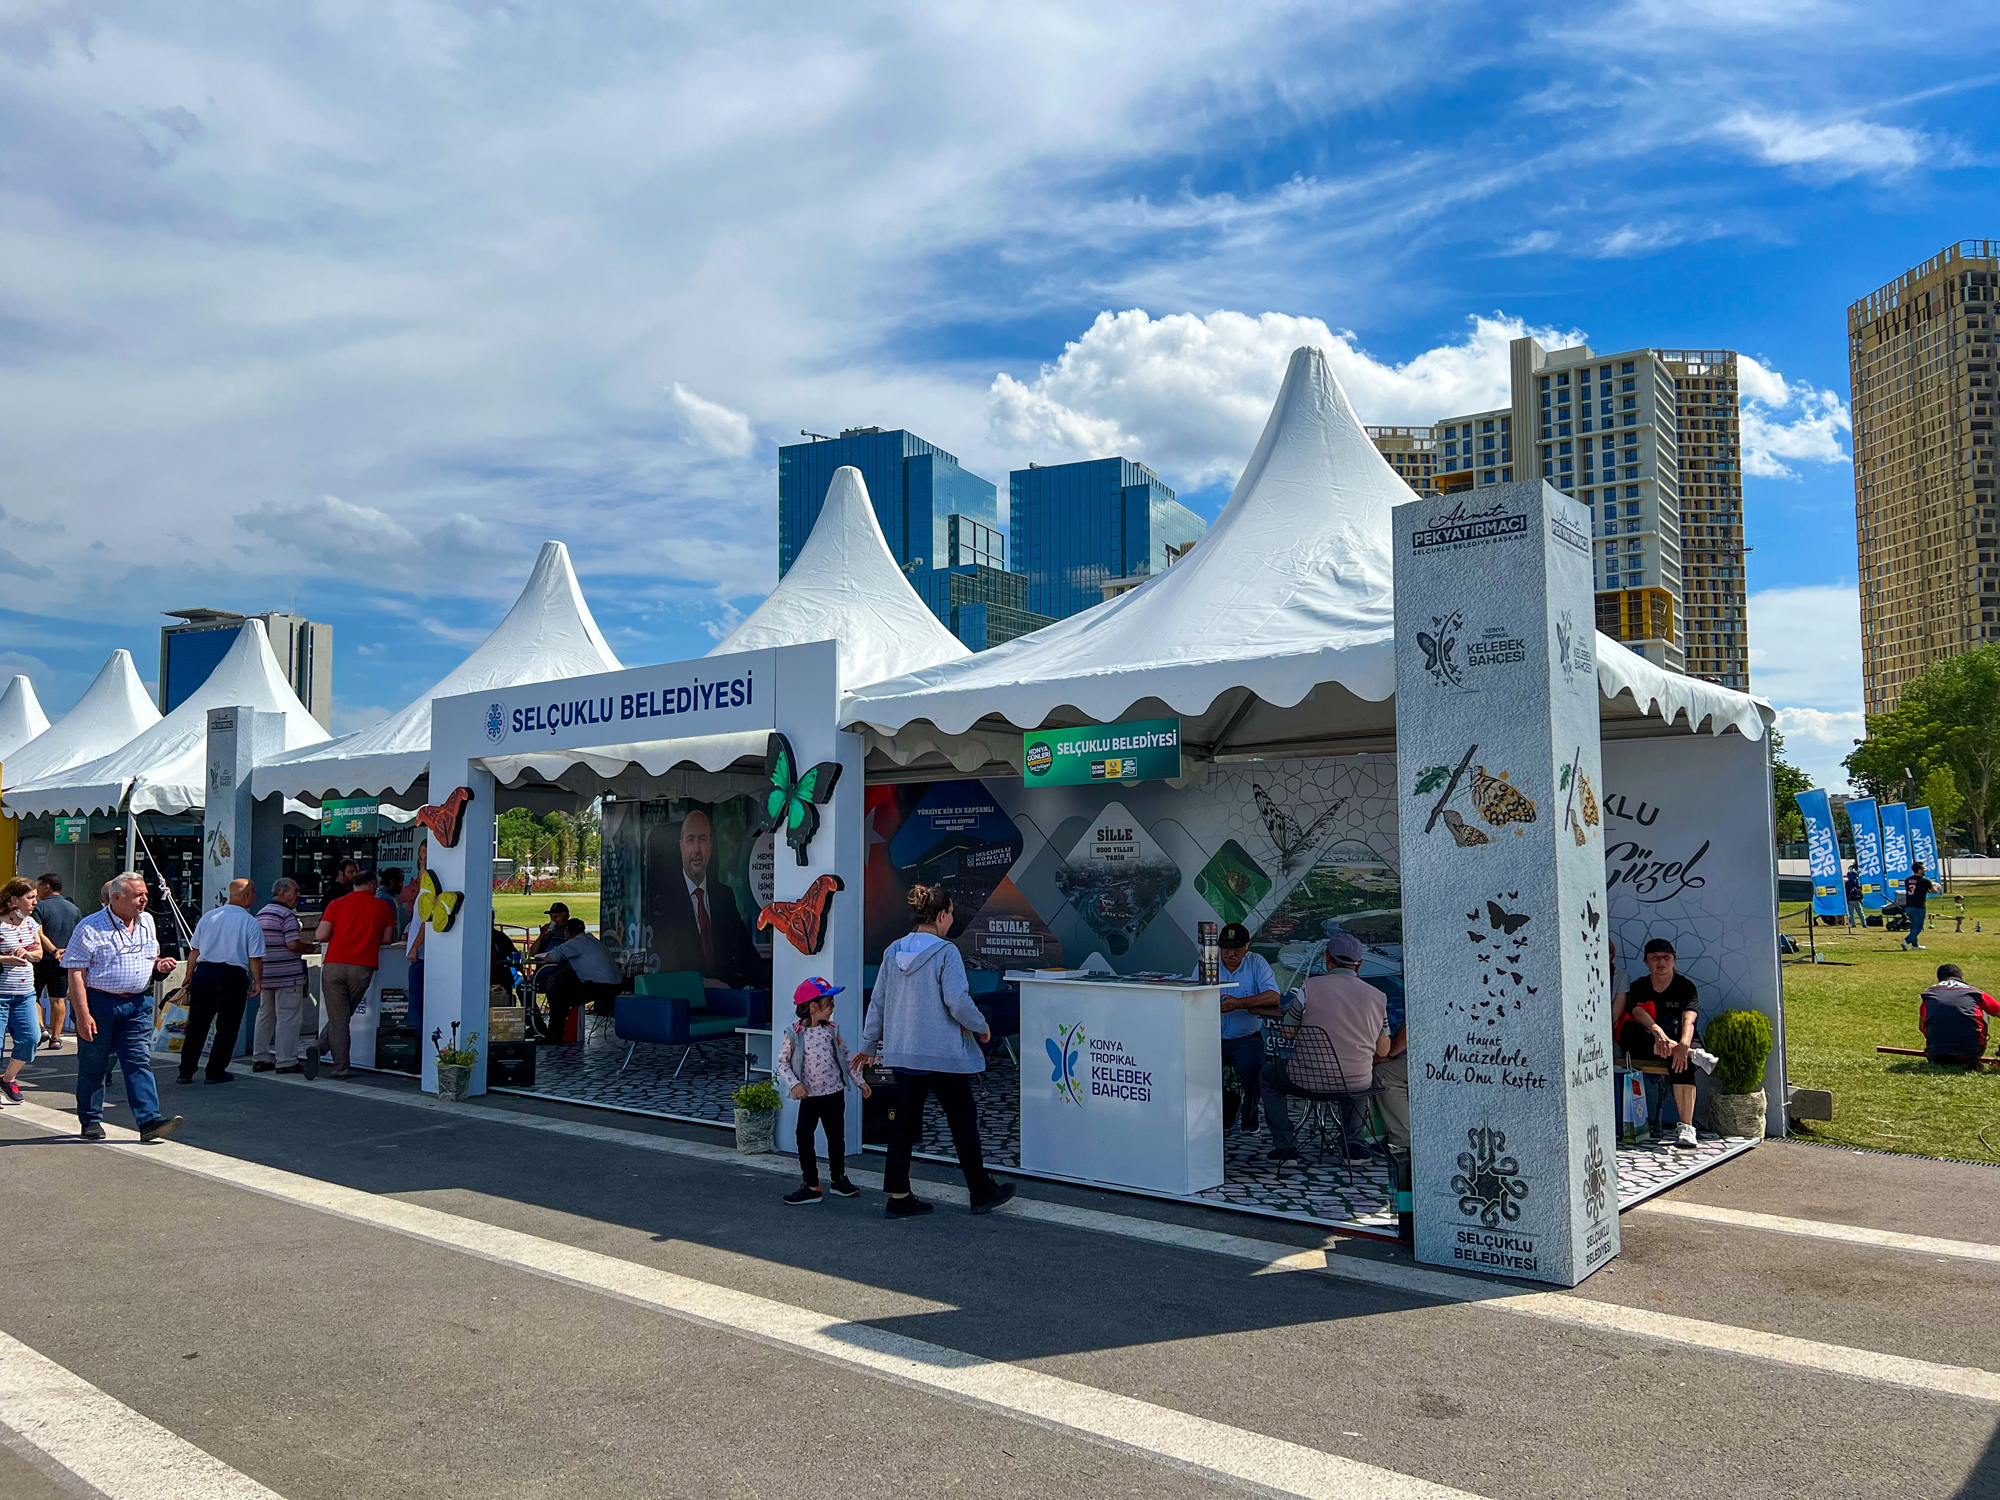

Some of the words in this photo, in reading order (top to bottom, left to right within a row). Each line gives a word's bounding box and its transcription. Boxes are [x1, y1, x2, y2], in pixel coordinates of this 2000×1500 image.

[1413, 515, 1525, 547] PEKYATIRMACI
[1467, 638, 1525, 654] KELEBEK
[512, 696, 614, 735] SELÇUKLU
[620, 669, 752, 720] BELEDİYESİ
[1057, 738, 1110, 757] SELÇUKLU
[1112, 728, 1177, 751] BELEDİYESİ
[964, 806, 994, 814] KAPSAMLI
[1097, 826, 1133, 841] SİLLE
[975, 847, 1011, 858] SELÇUKLU
[975, 852, 1012, 863] KONGRE
[1908, 884, 1917, 896] 3
[988, 920, 1030, 933] GEVALE
[986, 937, 1033, 947] MEDENİYETİN
[981, 947, 1012, 956] MUHAFIZ
[1013, 948, 1040, 957] KALESİ
[1089, 1039, 1123, 1052] KONYA
[1467, 1032, 1502, 1050] Hayat
[1444, 1044, 1528, 1067] Mucizelerle
[1092, 1066, 1152, 1086] KELEBEK
[1426, 1062, 1461, 1085] Dolu,
[1465, 1067, 1495, 1085] Onu
[1502, 1069, 1547, 1091] Keşfet
[1092, 1082, 1151, 1102] BAHÇESİ
[1457, 1231, 1533, 1253] SELÇUKLU
[1454, 1247, 1538, 1271] BELEDİYESİ
